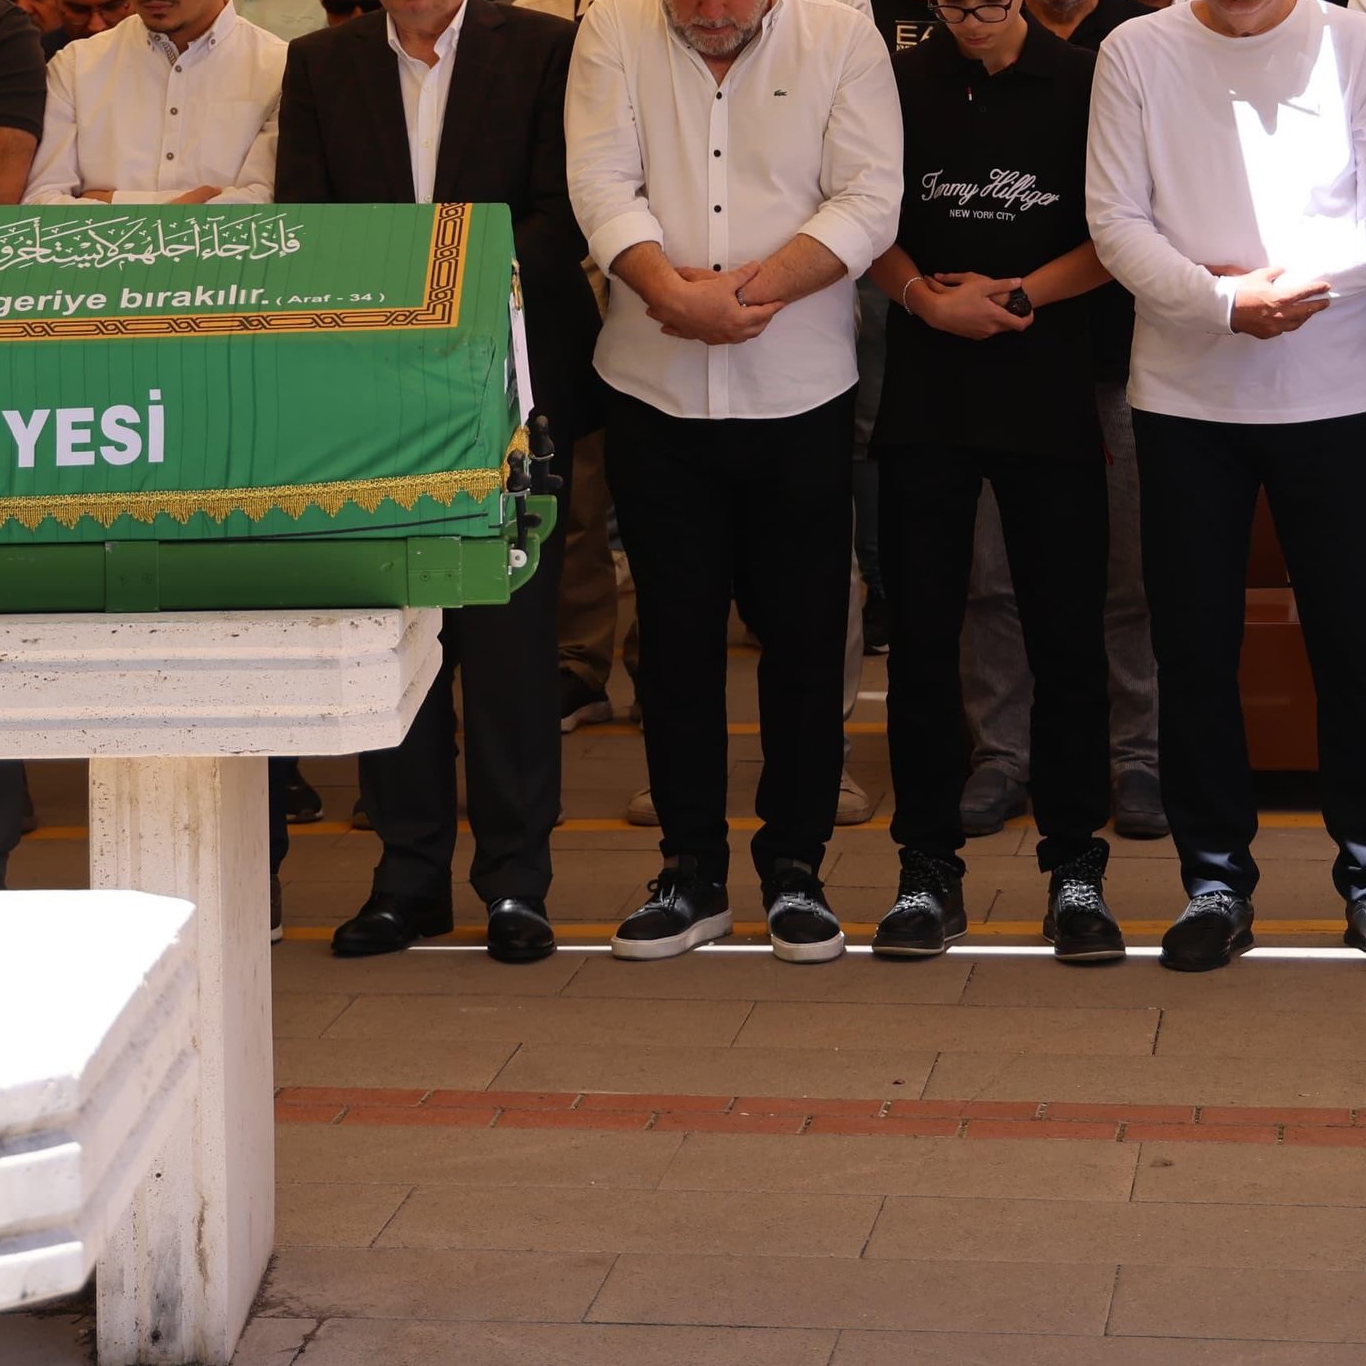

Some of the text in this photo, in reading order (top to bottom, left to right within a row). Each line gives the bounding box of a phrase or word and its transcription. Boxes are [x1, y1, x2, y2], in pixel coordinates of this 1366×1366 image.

[921, 168, 1060, 211] Tommy Hilfiger
[949, 209, 1017, 222] NEW YORK CITY
[120, 284, 269, 309] bırakılır.
[349, 292, 373, 303] 34
